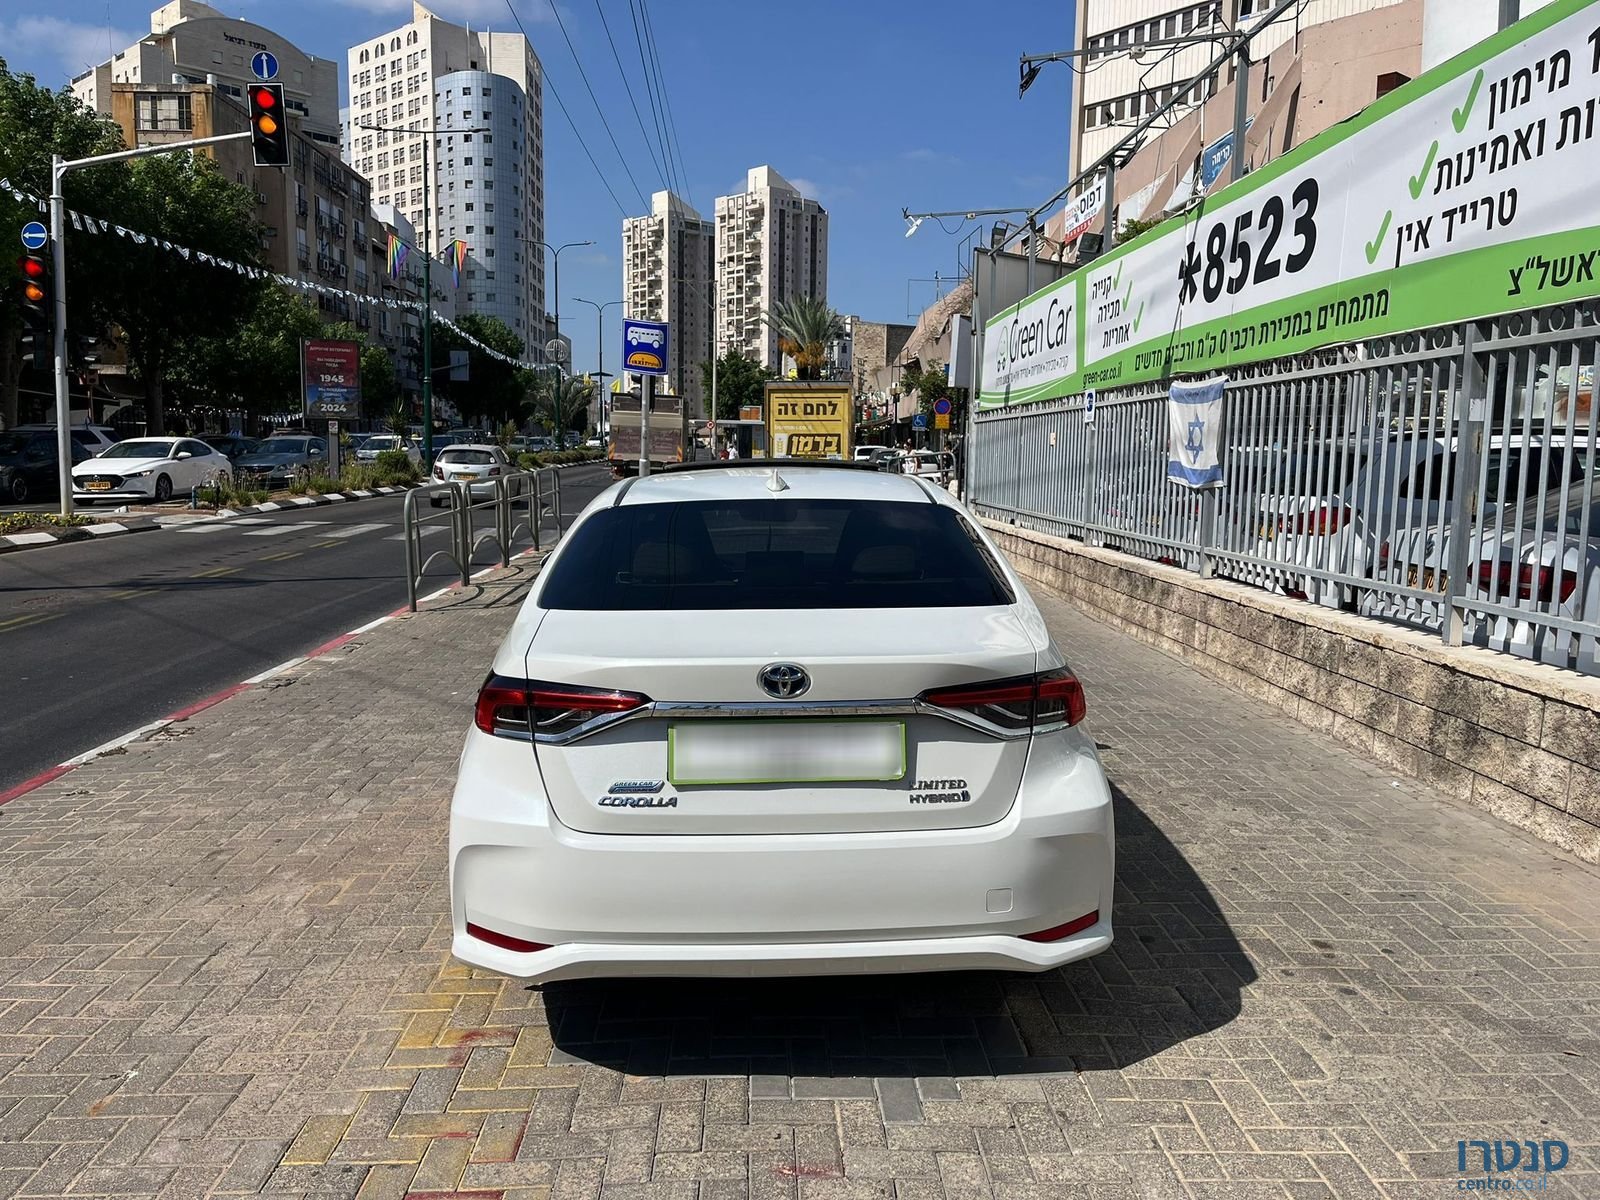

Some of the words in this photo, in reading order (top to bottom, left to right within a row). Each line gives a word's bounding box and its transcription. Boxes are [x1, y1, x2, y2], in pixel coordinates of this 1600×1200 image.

[1488, 48, 1571, 131] מימון
[1556, 97, 1600, 151] ות
[1433, 117, 1547, 195] ואמינות
[1080, 185, 1102, 214] דפוס
[1441, 187, 1519, 243] טרייד
[1394, 215, 1434, 268] אין
[1507, 249, 1600, 297] אשל"צ
[1092, 275, 1113, 300] קנייה
[1097, 299, 1121, 324] מכירה
[1316, 288, 1390, 331] מתמחים
[1009, 318, 1044, 363] Green
[1046, 298, 1073, 350] Car
[1102, 322, 1131, 349] אחריות
[1230, 325, 1256, 351] רכבי
[1258, 310, 1312, 346] במכירת
[1134, 348, 1163, 372] חדשים
[320, 374, 345, 383] 1945
[1083, 361, 1123, 388] green-car.co.il
[320, 404, 347, 412] 2024
[777, 402, 798, 416] זה
[803, 400, 839, 416] לחם
[791, 435, 839, 456] ברמן
[909, 792, 962, 804] HYBRID
[911, 779, 968, 791] LIMITED
[598, 796, 678, 808] COROLLA
